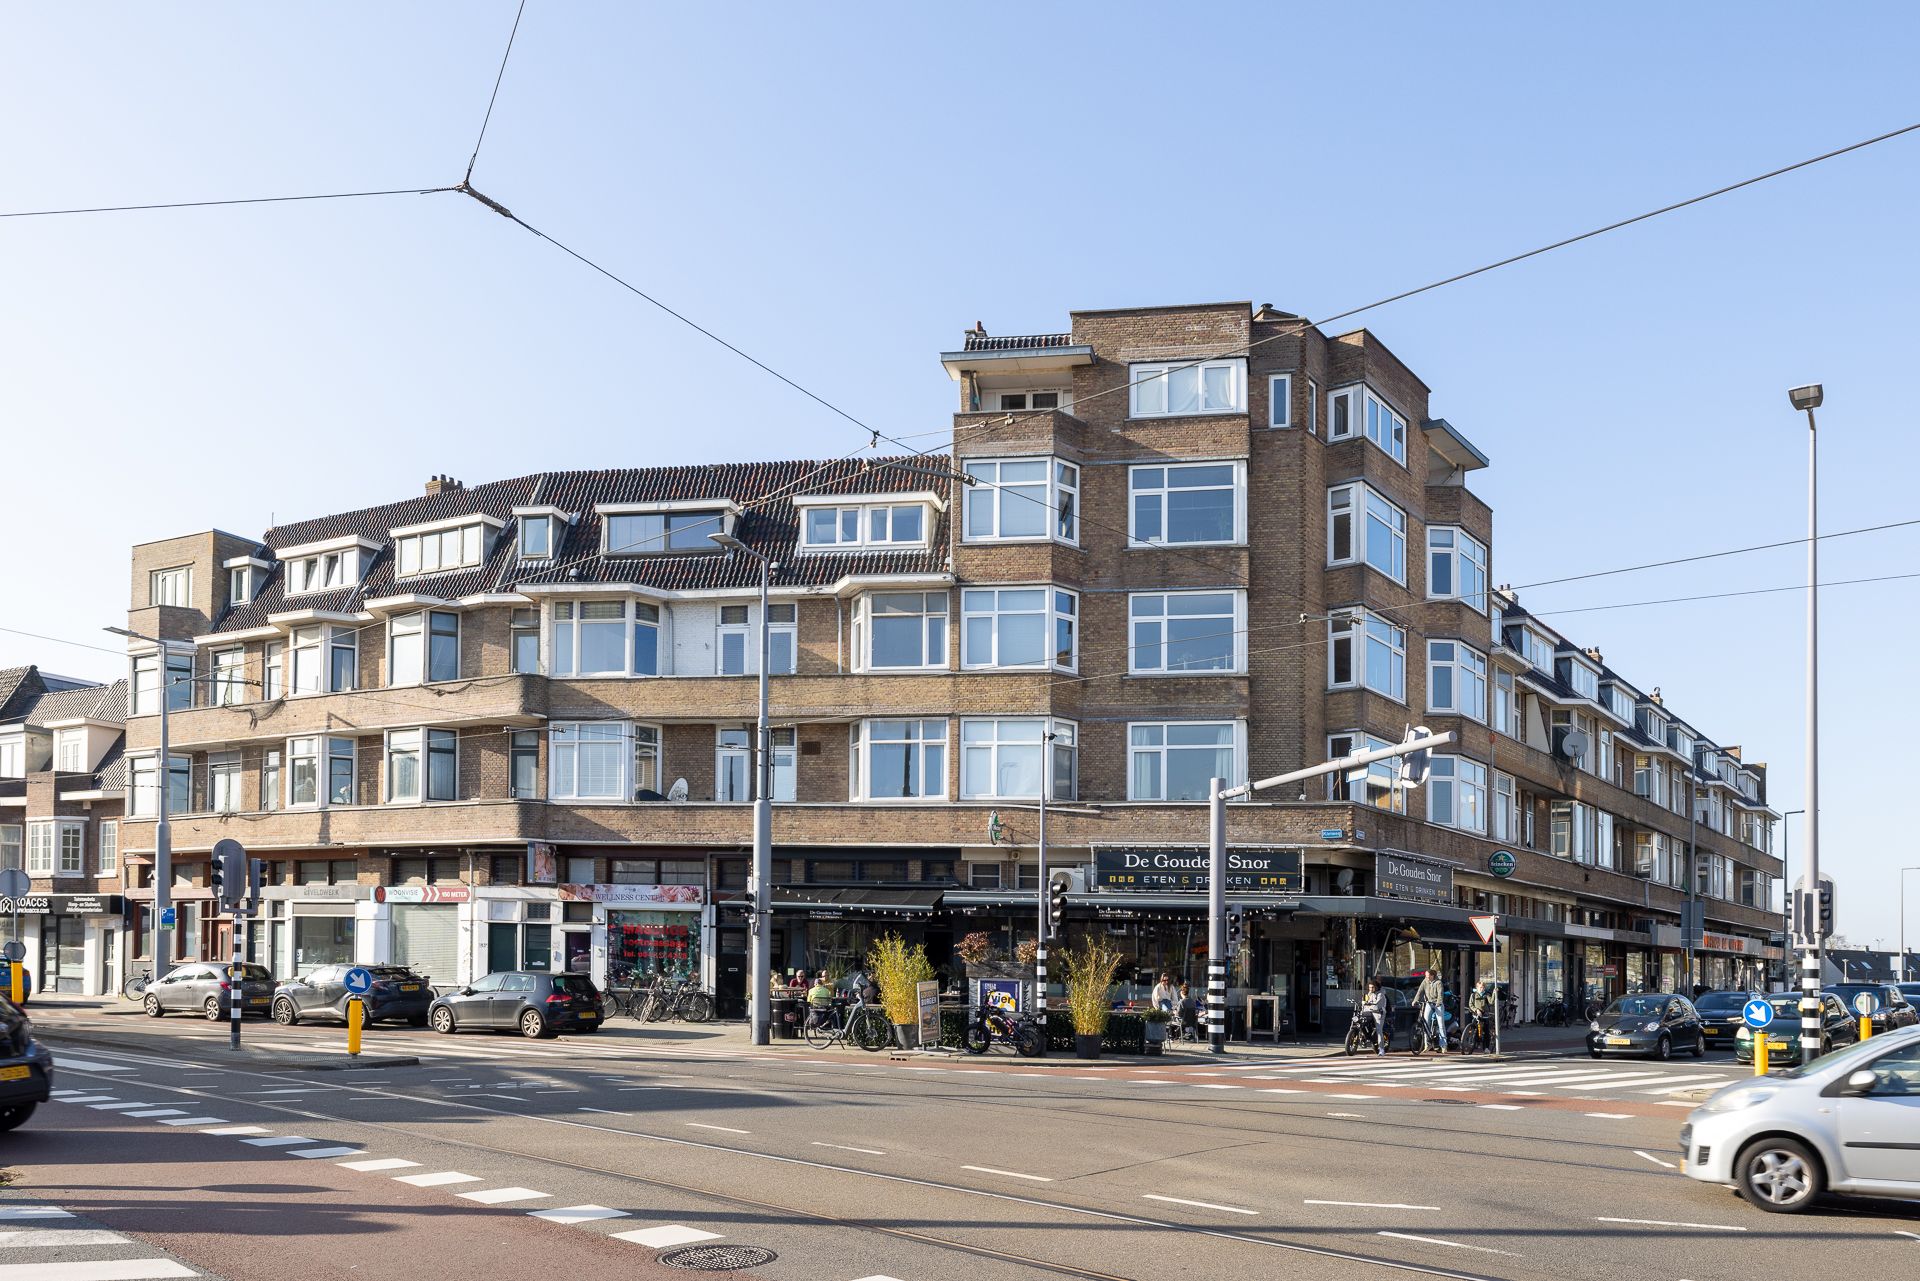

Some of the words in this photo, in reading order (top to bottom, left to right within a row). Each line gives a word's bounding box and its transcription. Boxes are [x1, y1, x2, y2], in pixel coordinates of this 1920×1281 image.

[1125, 854, 1149, 868] De
[1153, 854, 1211, 869] Goude
[1228, 854, 1271, 869] Snor
[1388, 861, 1399, 876] De
[1400, 864, 1425, 880] Gouden
[1426, 868, 1442, 882] Snor
[1143, 876, 1176, 884] ETEN
[1181, 876, 1190, 884] &
[1195, 876, 1251, 885] DRKEN
[1395, 883, 1409, 892] ETEN
[595, 893, 634, 901] WELLNESS
